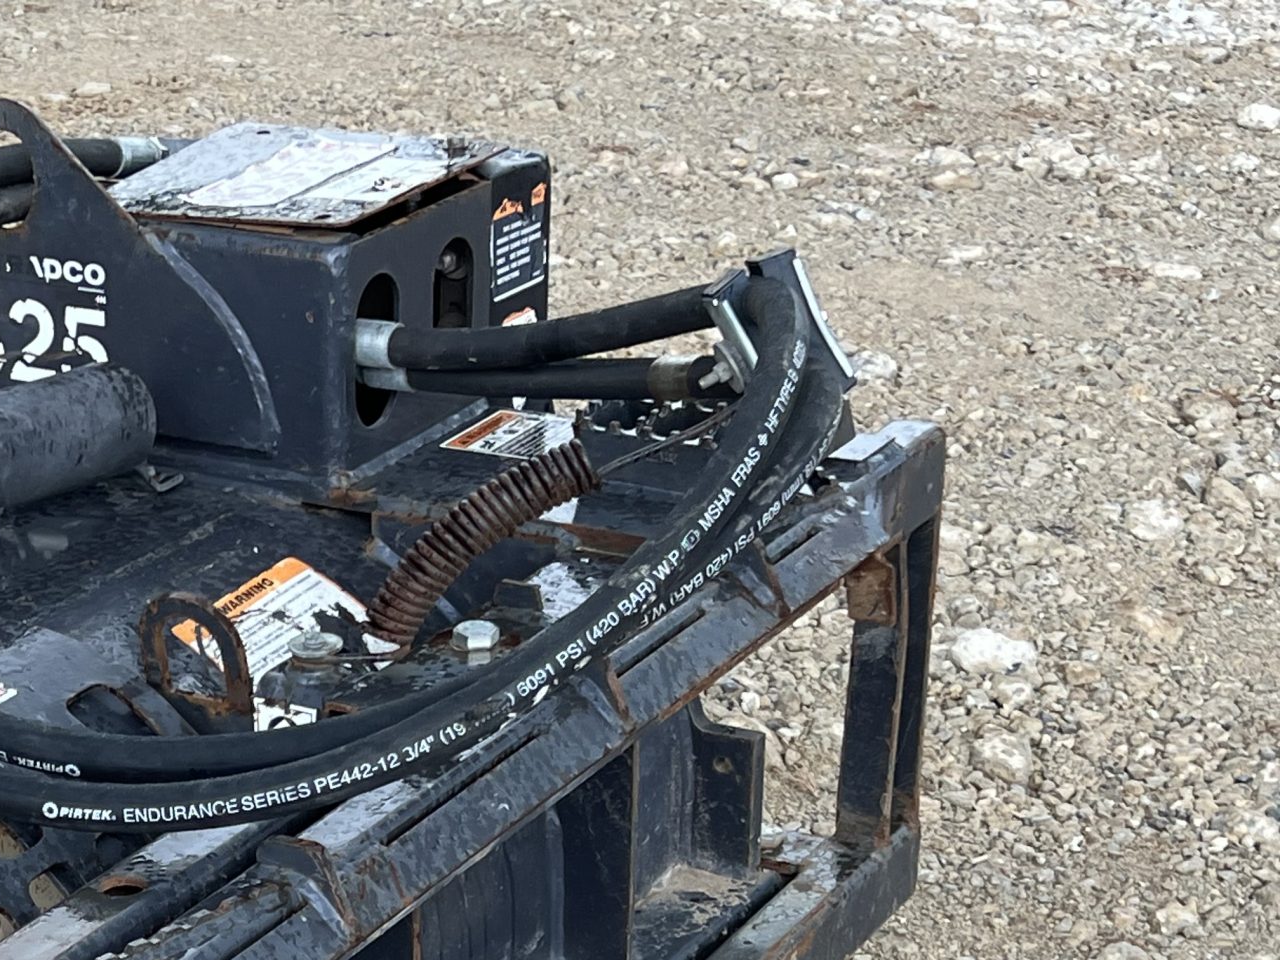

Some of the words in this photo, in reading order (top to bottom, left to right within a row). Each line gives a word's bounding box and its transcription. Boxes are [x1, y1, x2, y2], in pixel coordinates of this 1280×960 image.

[705, 547, 733, 578] (420
[123, 799, 239, 822] ENDURANCE
[241, 782, 312, 811] SERIES
[314, 753, 400, 795] PE442-12
[401, 734, 436, 761] 3/4"
[516, 663, 556, 697] 6091
[555, 639, 588, 669] PSI
[585, 616, 621, 646] (420
[618, 577, 657, 616] BAR)
[698, 487, 735, 531] MSHA
[730, 447, 761, 488] FRAS
[764, 408, 780, 434] HF
[773, 377, 796, 413] TYPE
[787, 368, 799, 384] B
[220, 577, 275, 617] WARNING
